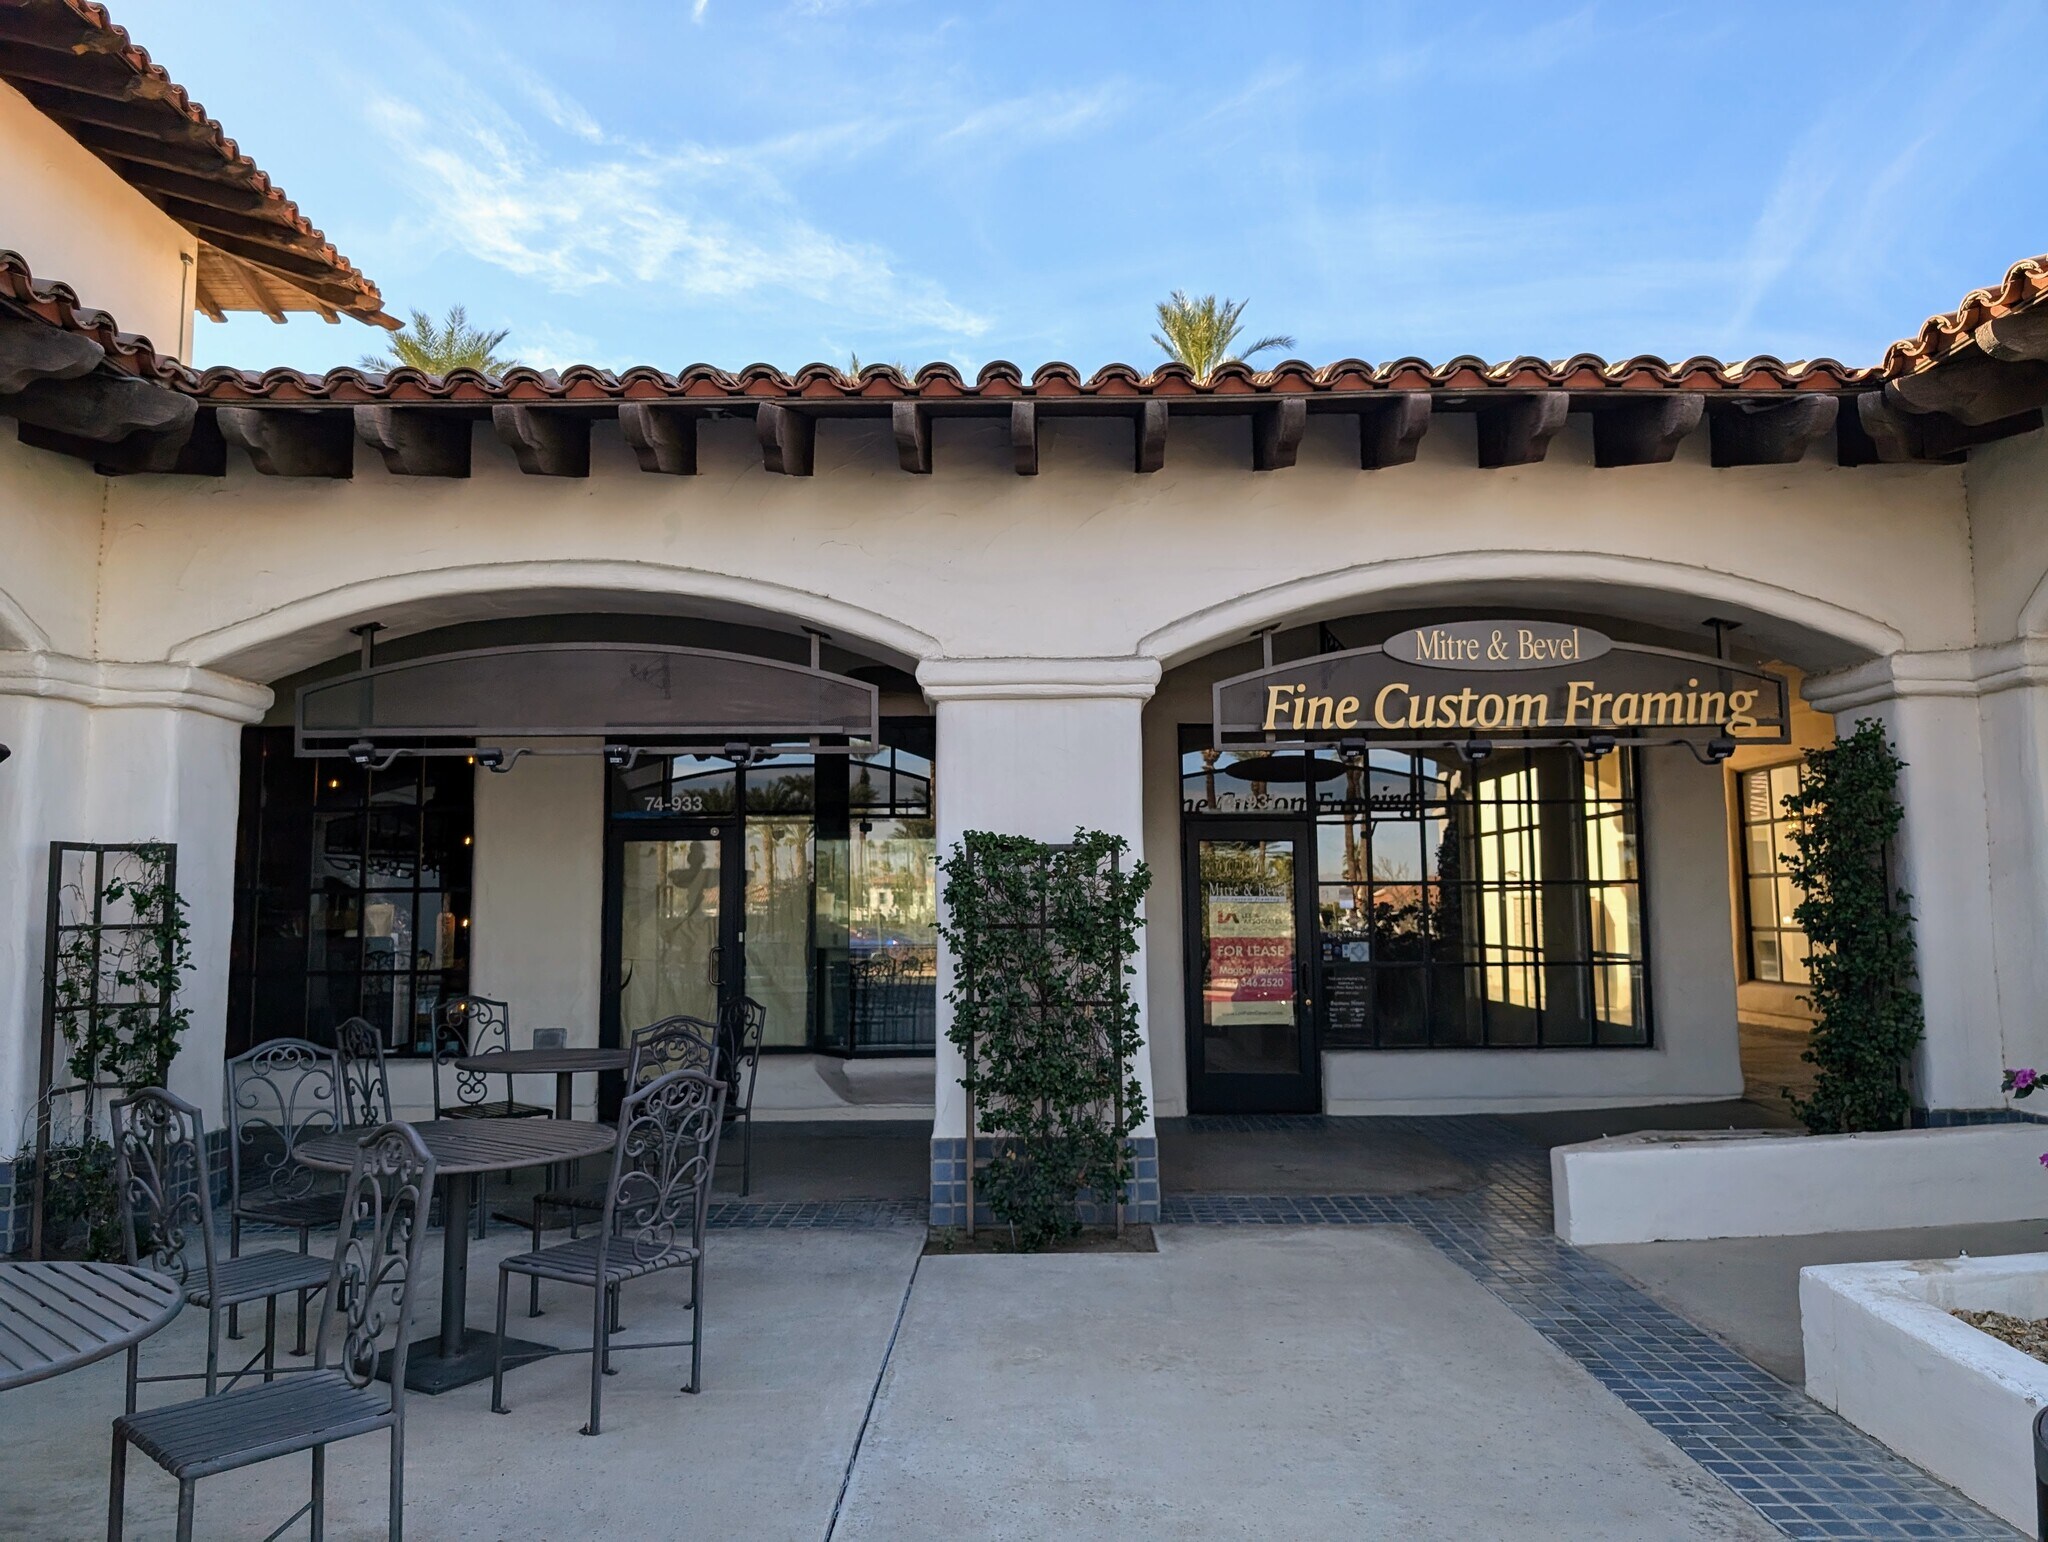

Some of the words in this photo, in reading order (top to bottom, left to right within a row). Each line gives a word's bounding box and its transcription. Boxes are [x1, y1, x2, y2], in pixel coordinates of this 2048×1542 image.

[1415, 629, 1480, 661] Mitre
[1487, 629, 1509, 661] &
[1517, 627, 1580, 660] Bevel
[1261, 683, 1359, 731] Fine
[1374, 683, 1548, 729] Custom
[1563, 678, 1759, 736] Framing
[644, 796, 703, 812] 74-933
[1217, 945, 1243, 957] FOR
[1247, 945, 1285, 957] LEASE
